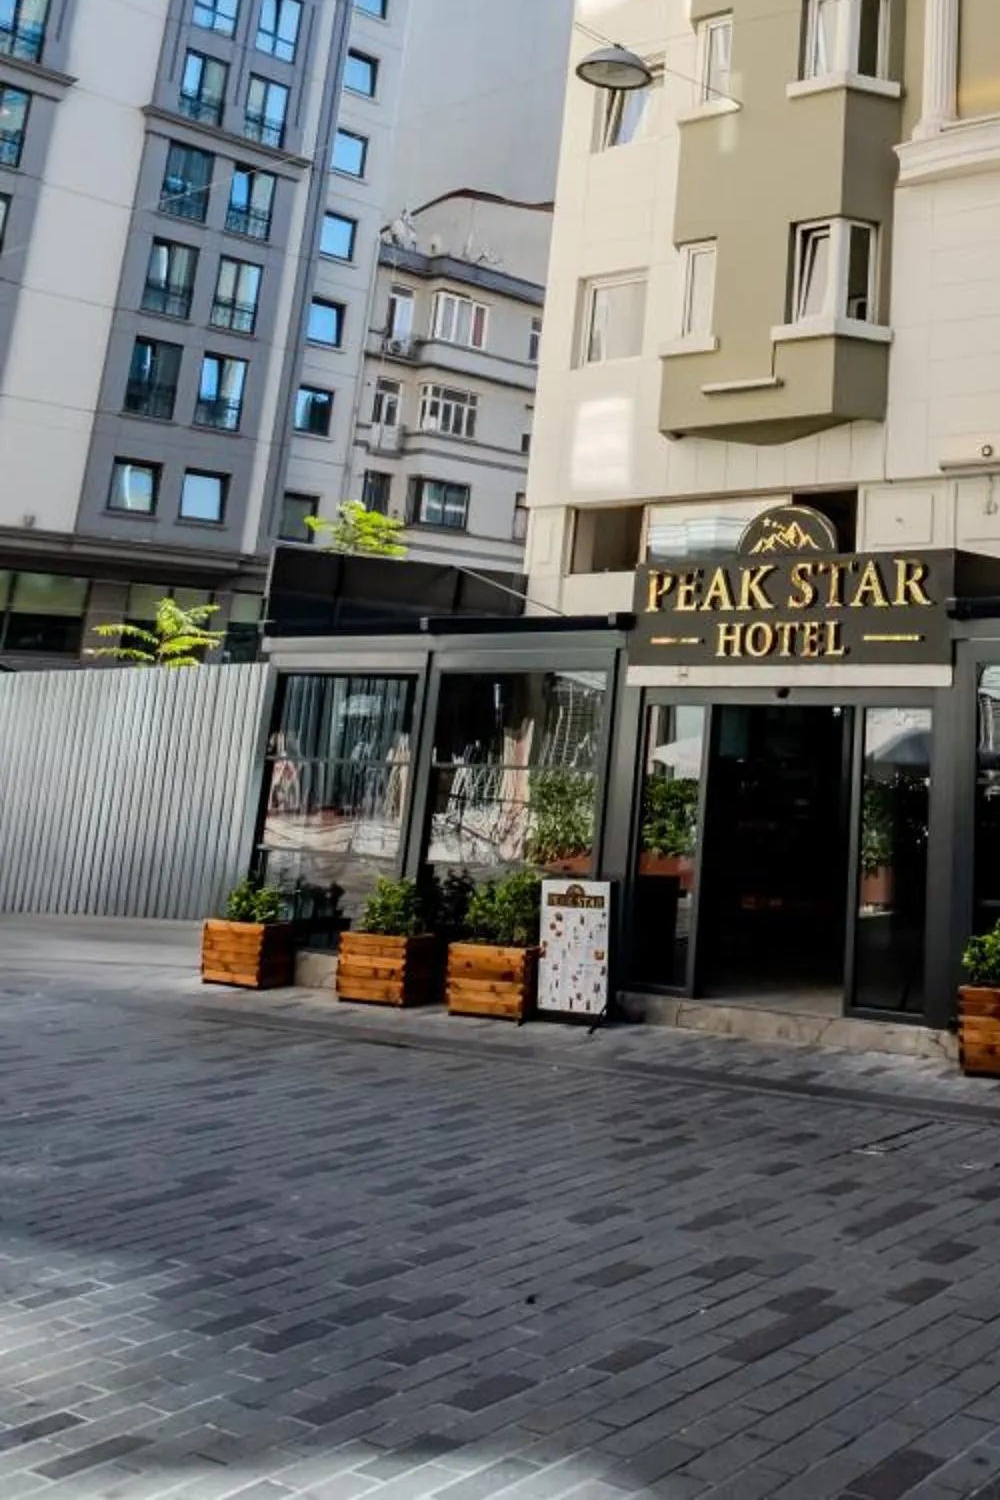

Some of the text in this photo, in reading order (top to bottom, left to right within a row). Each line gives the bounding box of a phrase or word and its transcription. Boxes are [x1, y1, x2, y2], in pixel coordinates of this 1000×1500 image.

[645, 559, 933, 613] PEAK STAR
[715, 621, 847, 658] HOTEL
